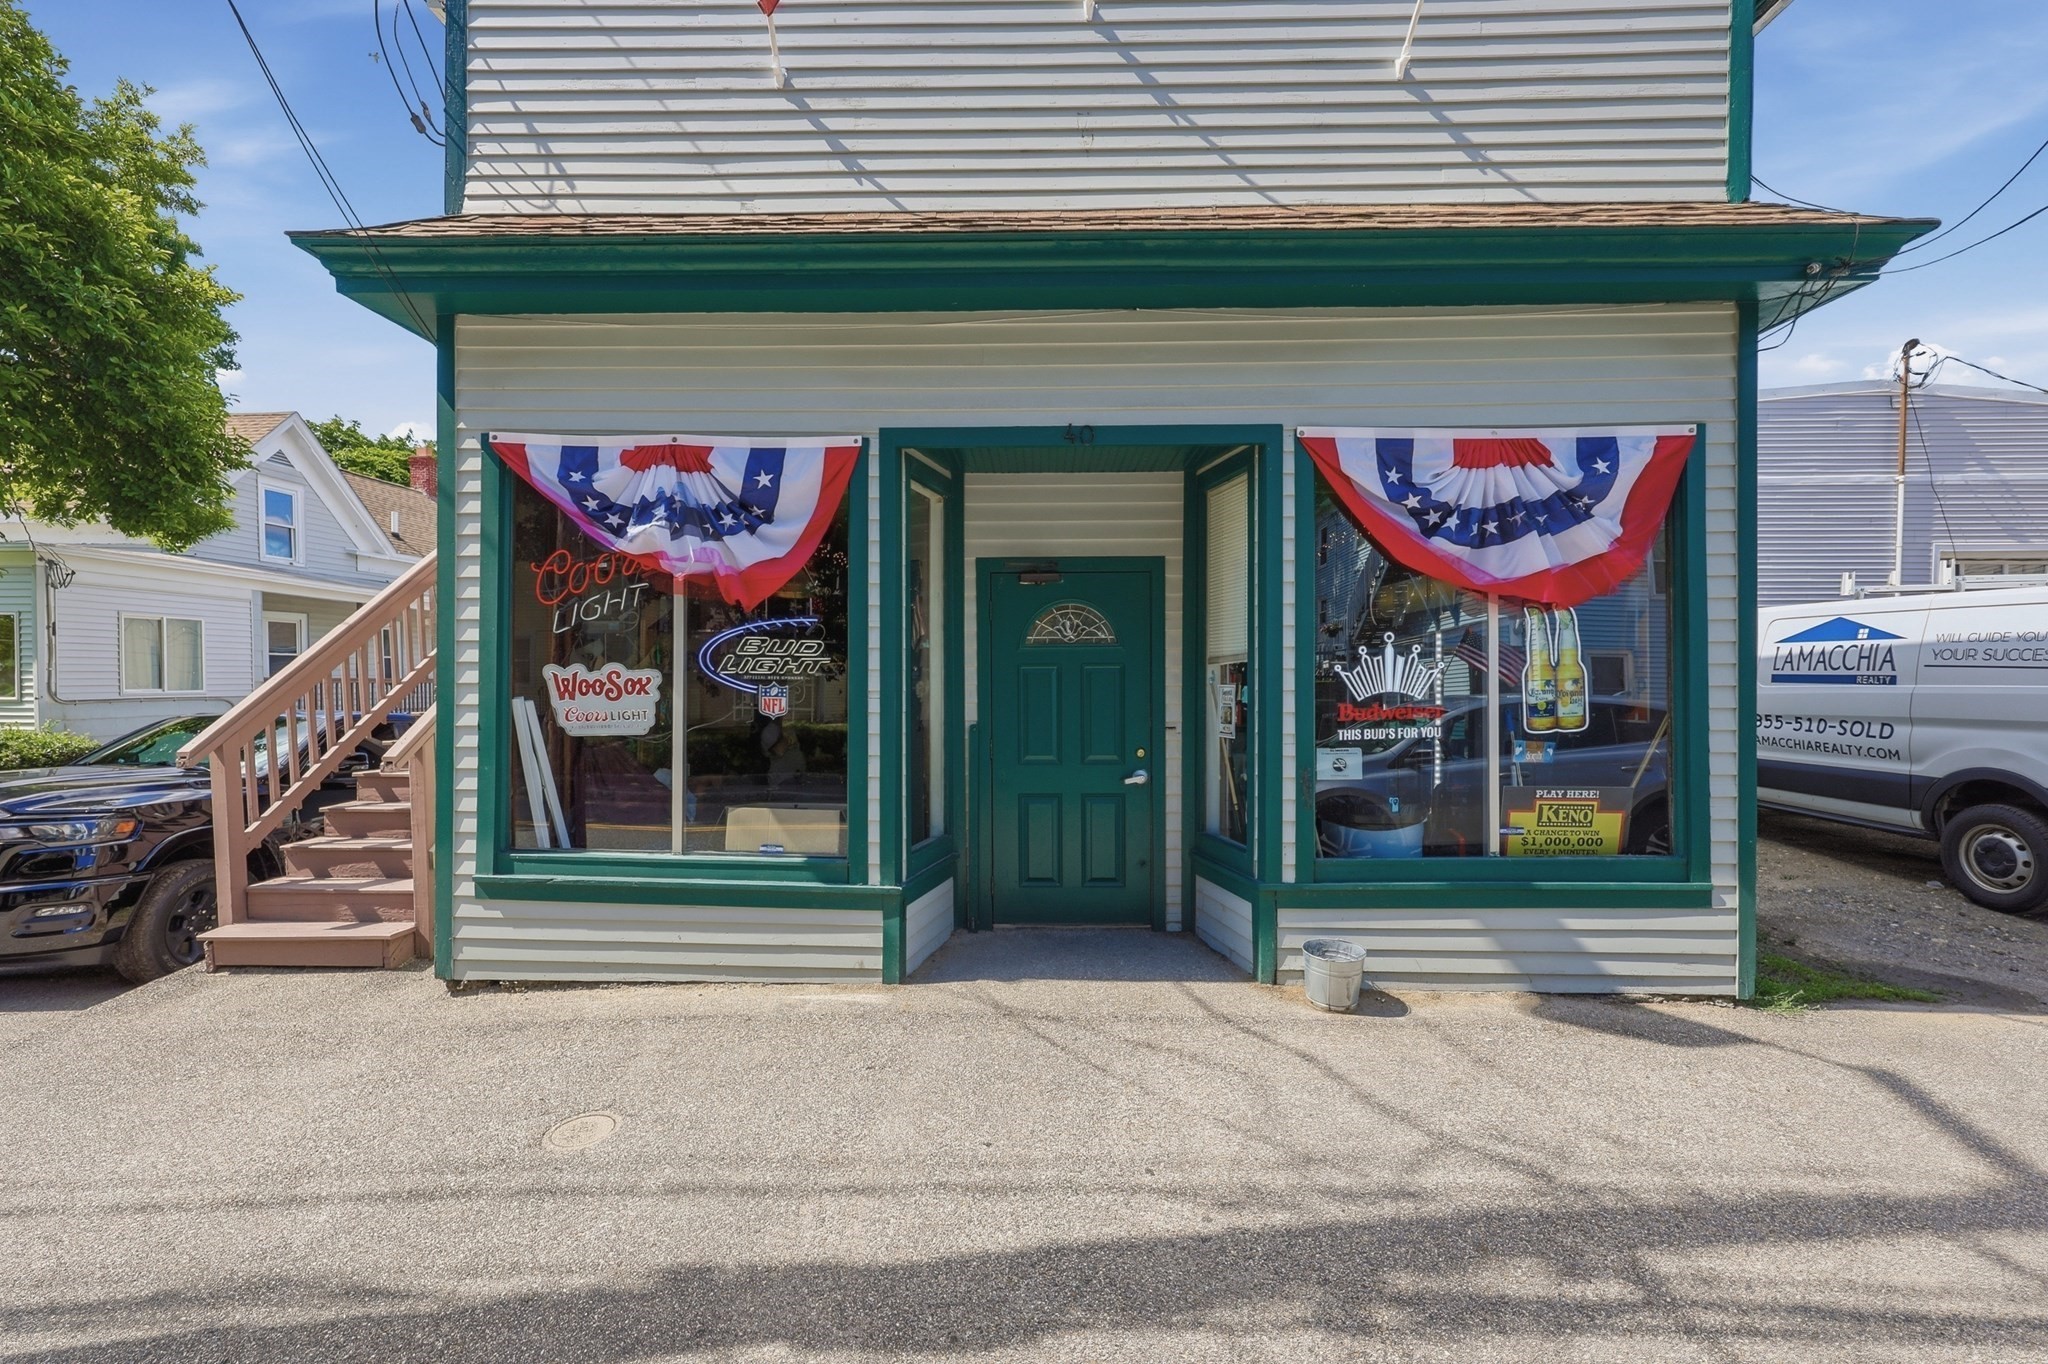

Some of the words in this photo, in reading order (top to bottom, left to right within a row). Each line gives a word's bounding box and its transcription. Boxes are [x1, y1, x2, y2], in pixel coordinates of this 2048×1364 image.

[1063, 422, 1095, 446] 40
[553, 583, 649, 634] LIGHT
[1936, 632, 1963, 643] WILL
[1967, 631, 2012, 643] GUIDE
[736, 636, 825, 656] BUD
[1773, 643, 1896, 671] LAMACCHIA
[1932, 648, 1979, 661] YOUR
[717, 654, 831, 674] LIGHT
[551, 670, 652, 702] WooSox
[1856, 675, 1891, 685] REALTY
[763, 698, 785, 713] NFL
[1337, 702, 1445, 721] Budweiser
[564, 706, 608, 722] Coors
[610, 710, 648, 721] LIGHT
[1337, 729, 1361, 741] THIS
[1364, 728, 1395, 740] BUD'S
[1398, 727, 1418, 739] FOR
[1420, 727, 1441, 738] YOU
[1536, 789, 1565, 799] PLAY
[1566, 789, 1600, 799] HERE!
[1541, 805, 1593, 823] KENO
[1521, 837, 1604, 848] $1,000,000
[1558, 848, 1599, 856] MINUTES!
